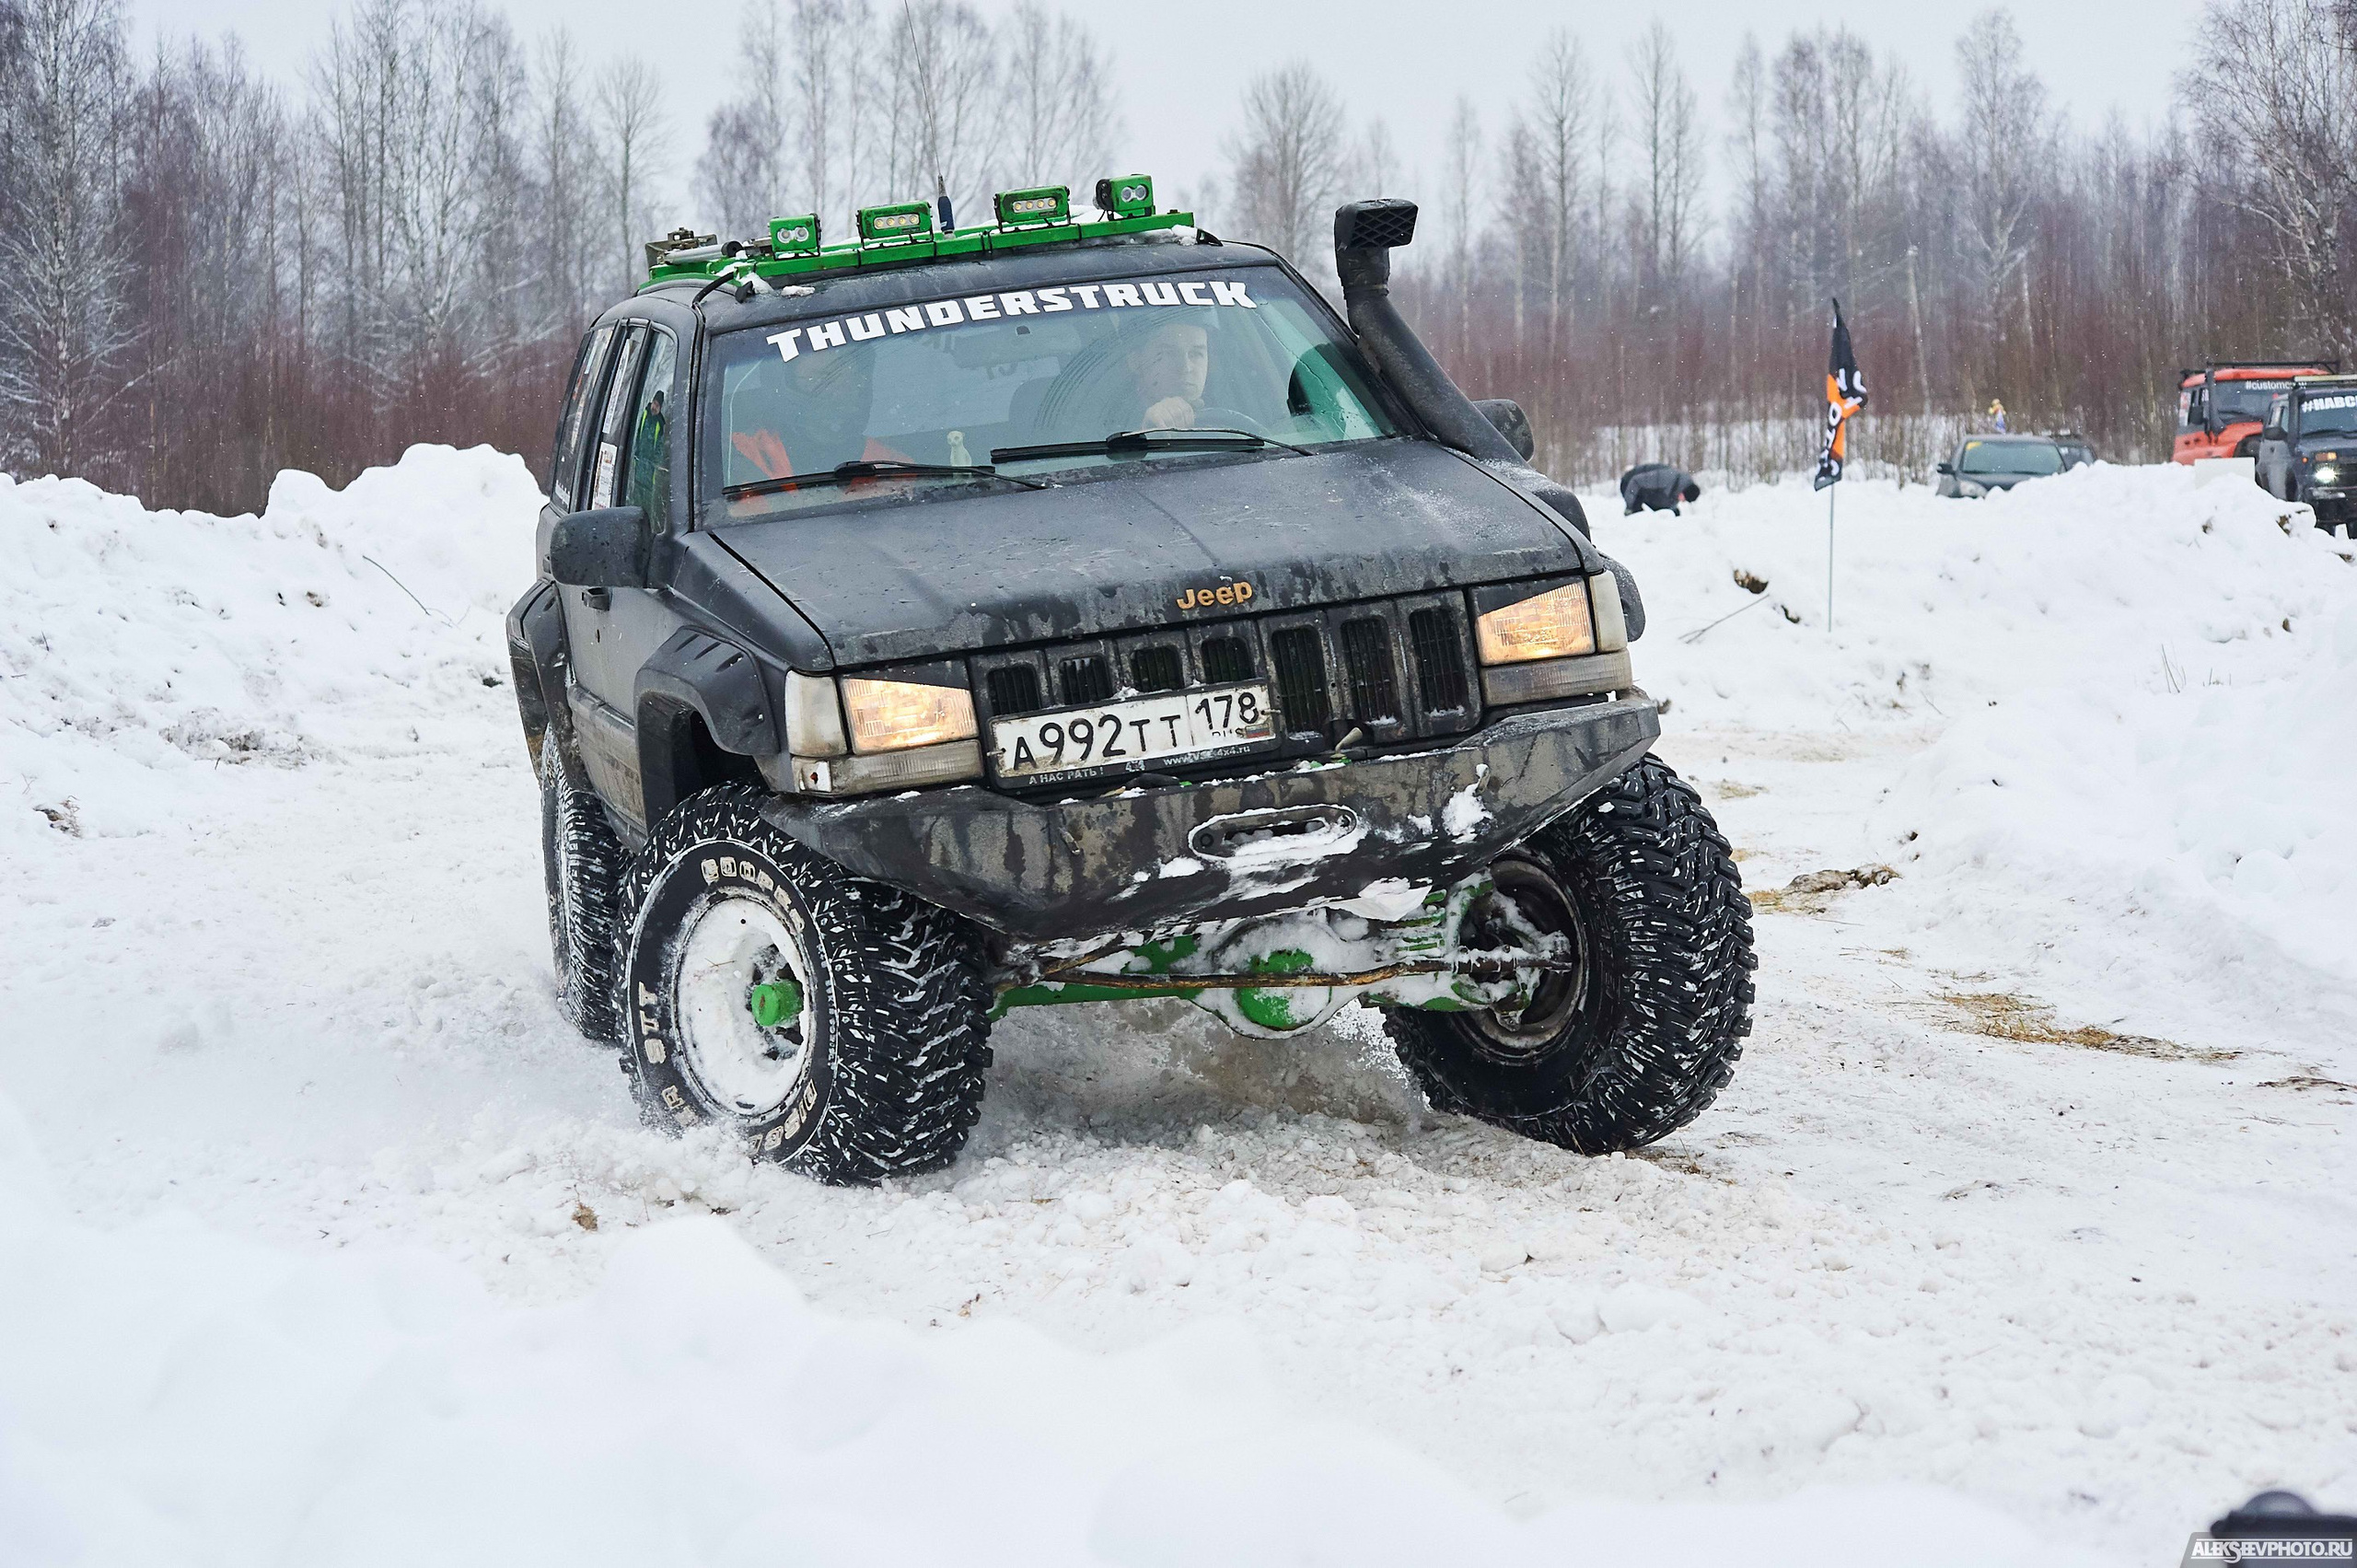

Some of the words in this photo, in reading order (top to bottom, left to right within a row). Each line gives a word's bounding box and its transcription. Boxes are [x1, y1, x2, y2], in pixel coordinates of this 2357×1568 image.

[766, 281, 1257, 363] THUNDERSTRUCK
[1177, 580, 1254, 610] Jeep
[1195, 692, 1260, 730] 178
[1040, 772, 1063, 784] НАС
[1068, 768, 1097, 780] РАТЬ
